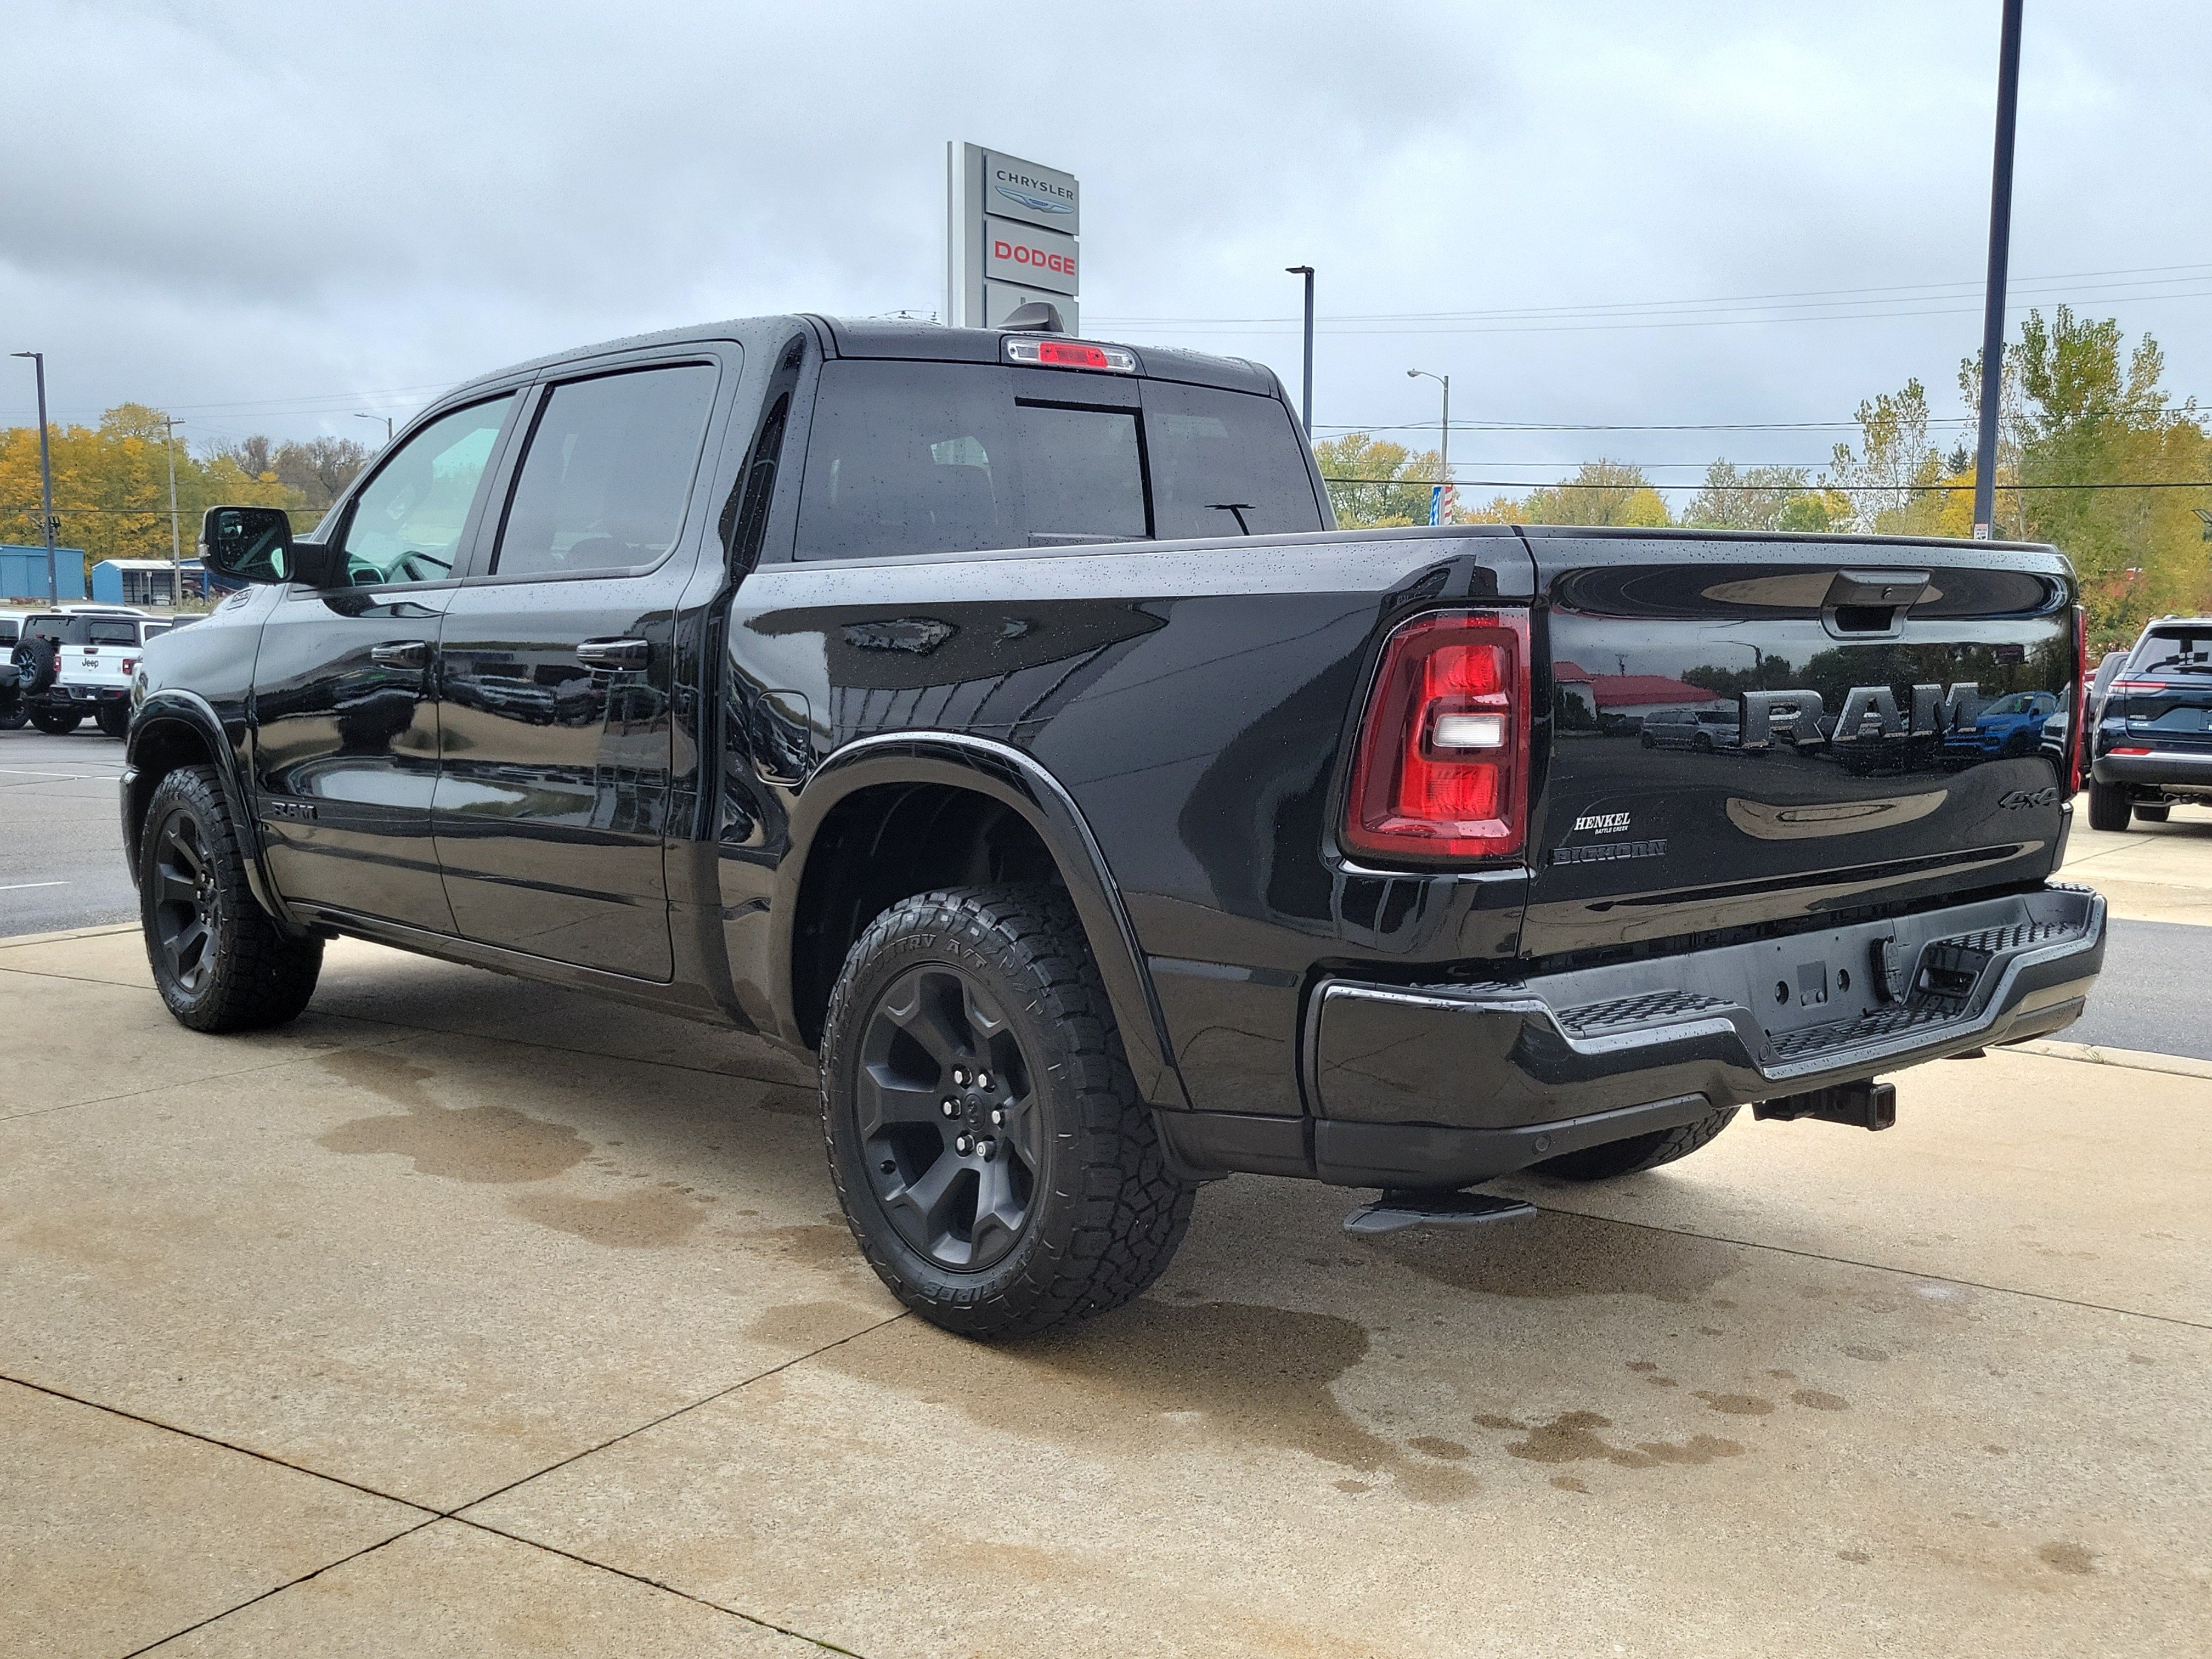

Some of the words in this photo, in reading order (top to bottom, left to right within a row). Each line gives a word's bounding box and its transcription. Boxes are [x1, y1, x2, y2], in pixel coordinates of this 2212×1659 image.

[996, 170, 1074, 200] CHRYSLER
[994, 240, 1075, 276] DODGE
[82, 658, 99, 669] Jeep
[1739, 682, 1979, 749] RAM
[271, 801, 318, 821] RAM
[1573, 812, 1631, 831] HENKEL
[1595, 827, 1613, 835] BATTLE
